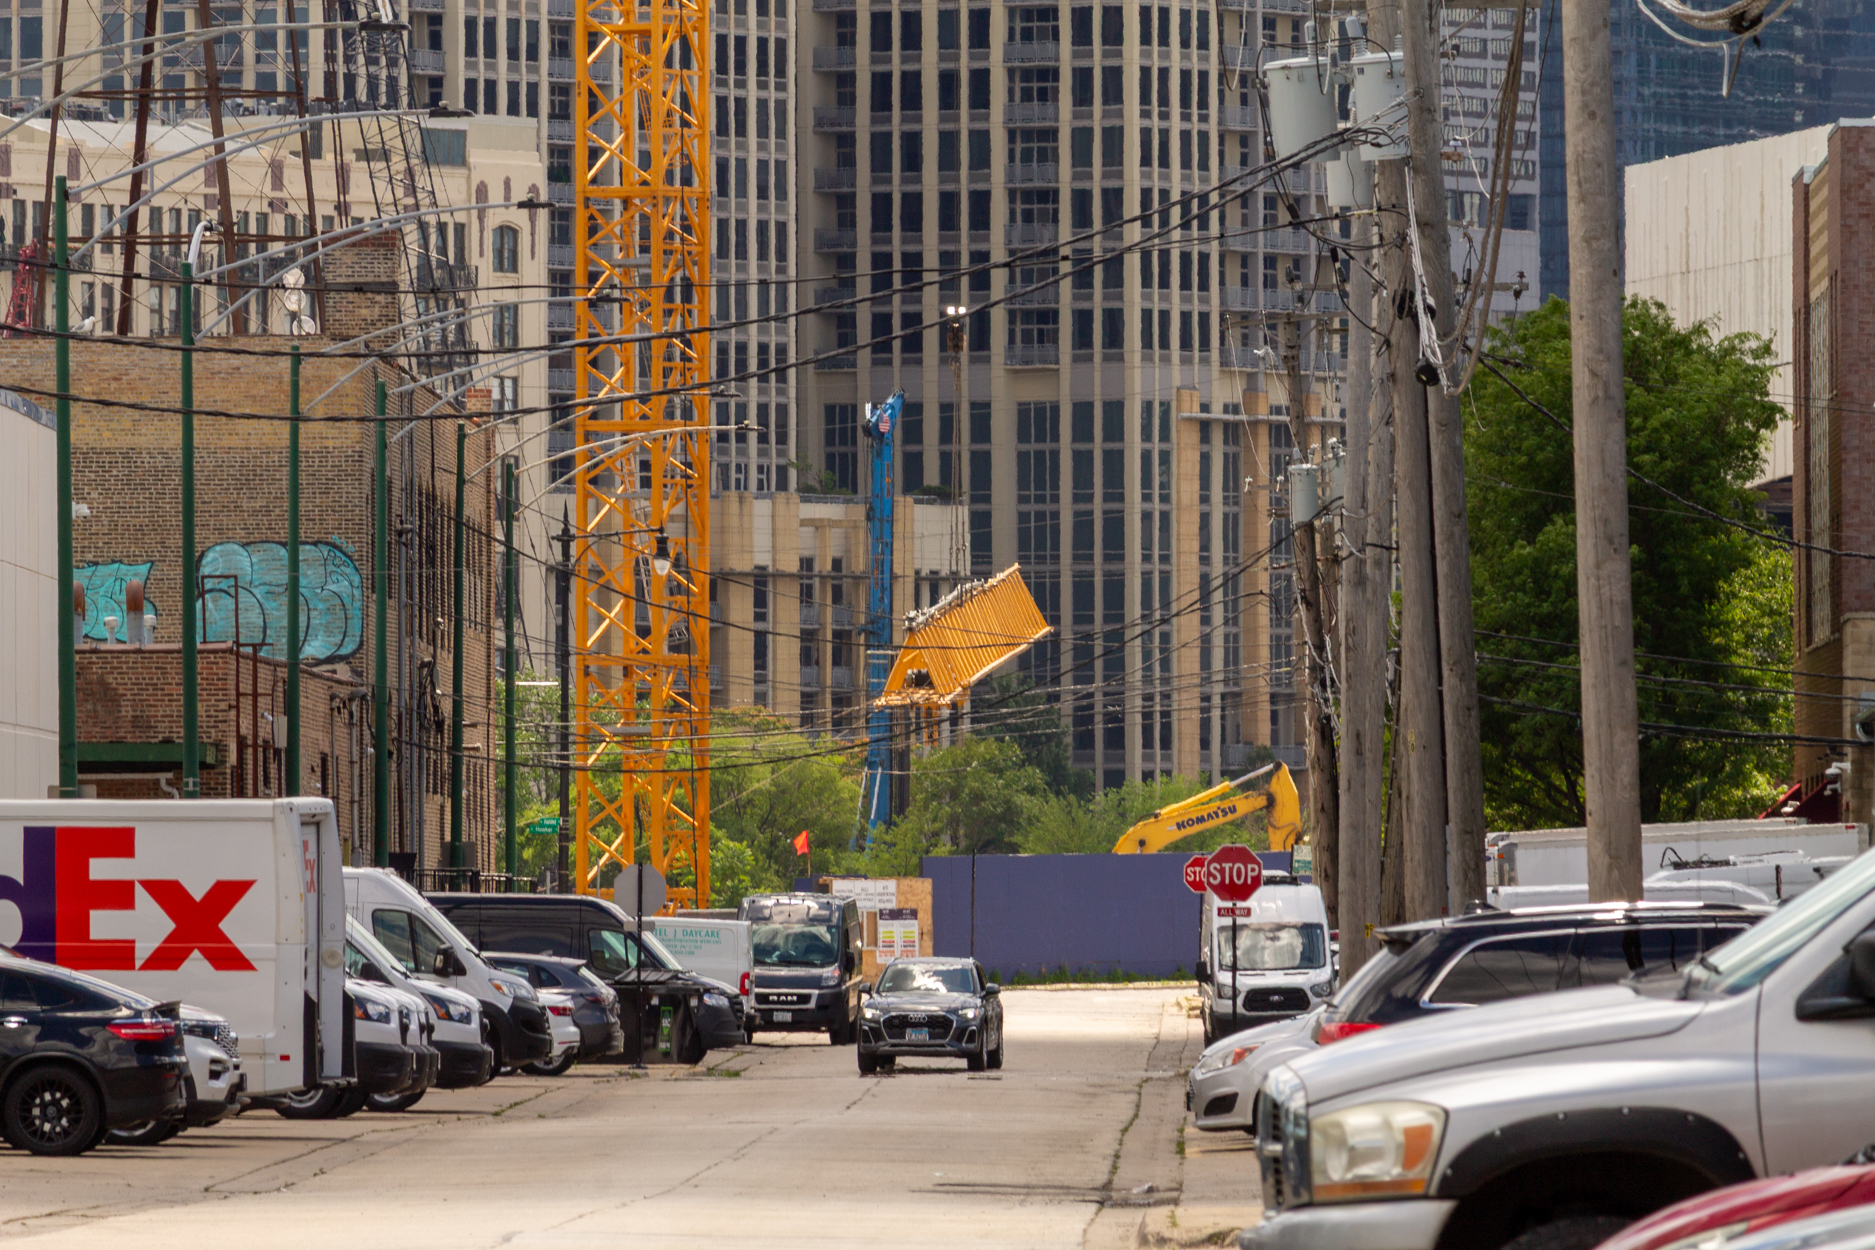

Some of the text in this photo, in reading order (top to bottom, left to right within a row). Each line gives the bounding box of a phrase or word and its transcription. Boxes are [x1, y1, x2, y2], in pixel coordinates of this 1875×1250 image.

[1176, 804, 1237, 831] KOMATSU
[1186, 867, 1206, 882] STO
[1209, 862, 1259, 885] STOP
[1220, 908, 1248, 916] ALL WAY
[651, 928, 668, 937] TEL
[682, 929, 721, 938] DAYCARE
